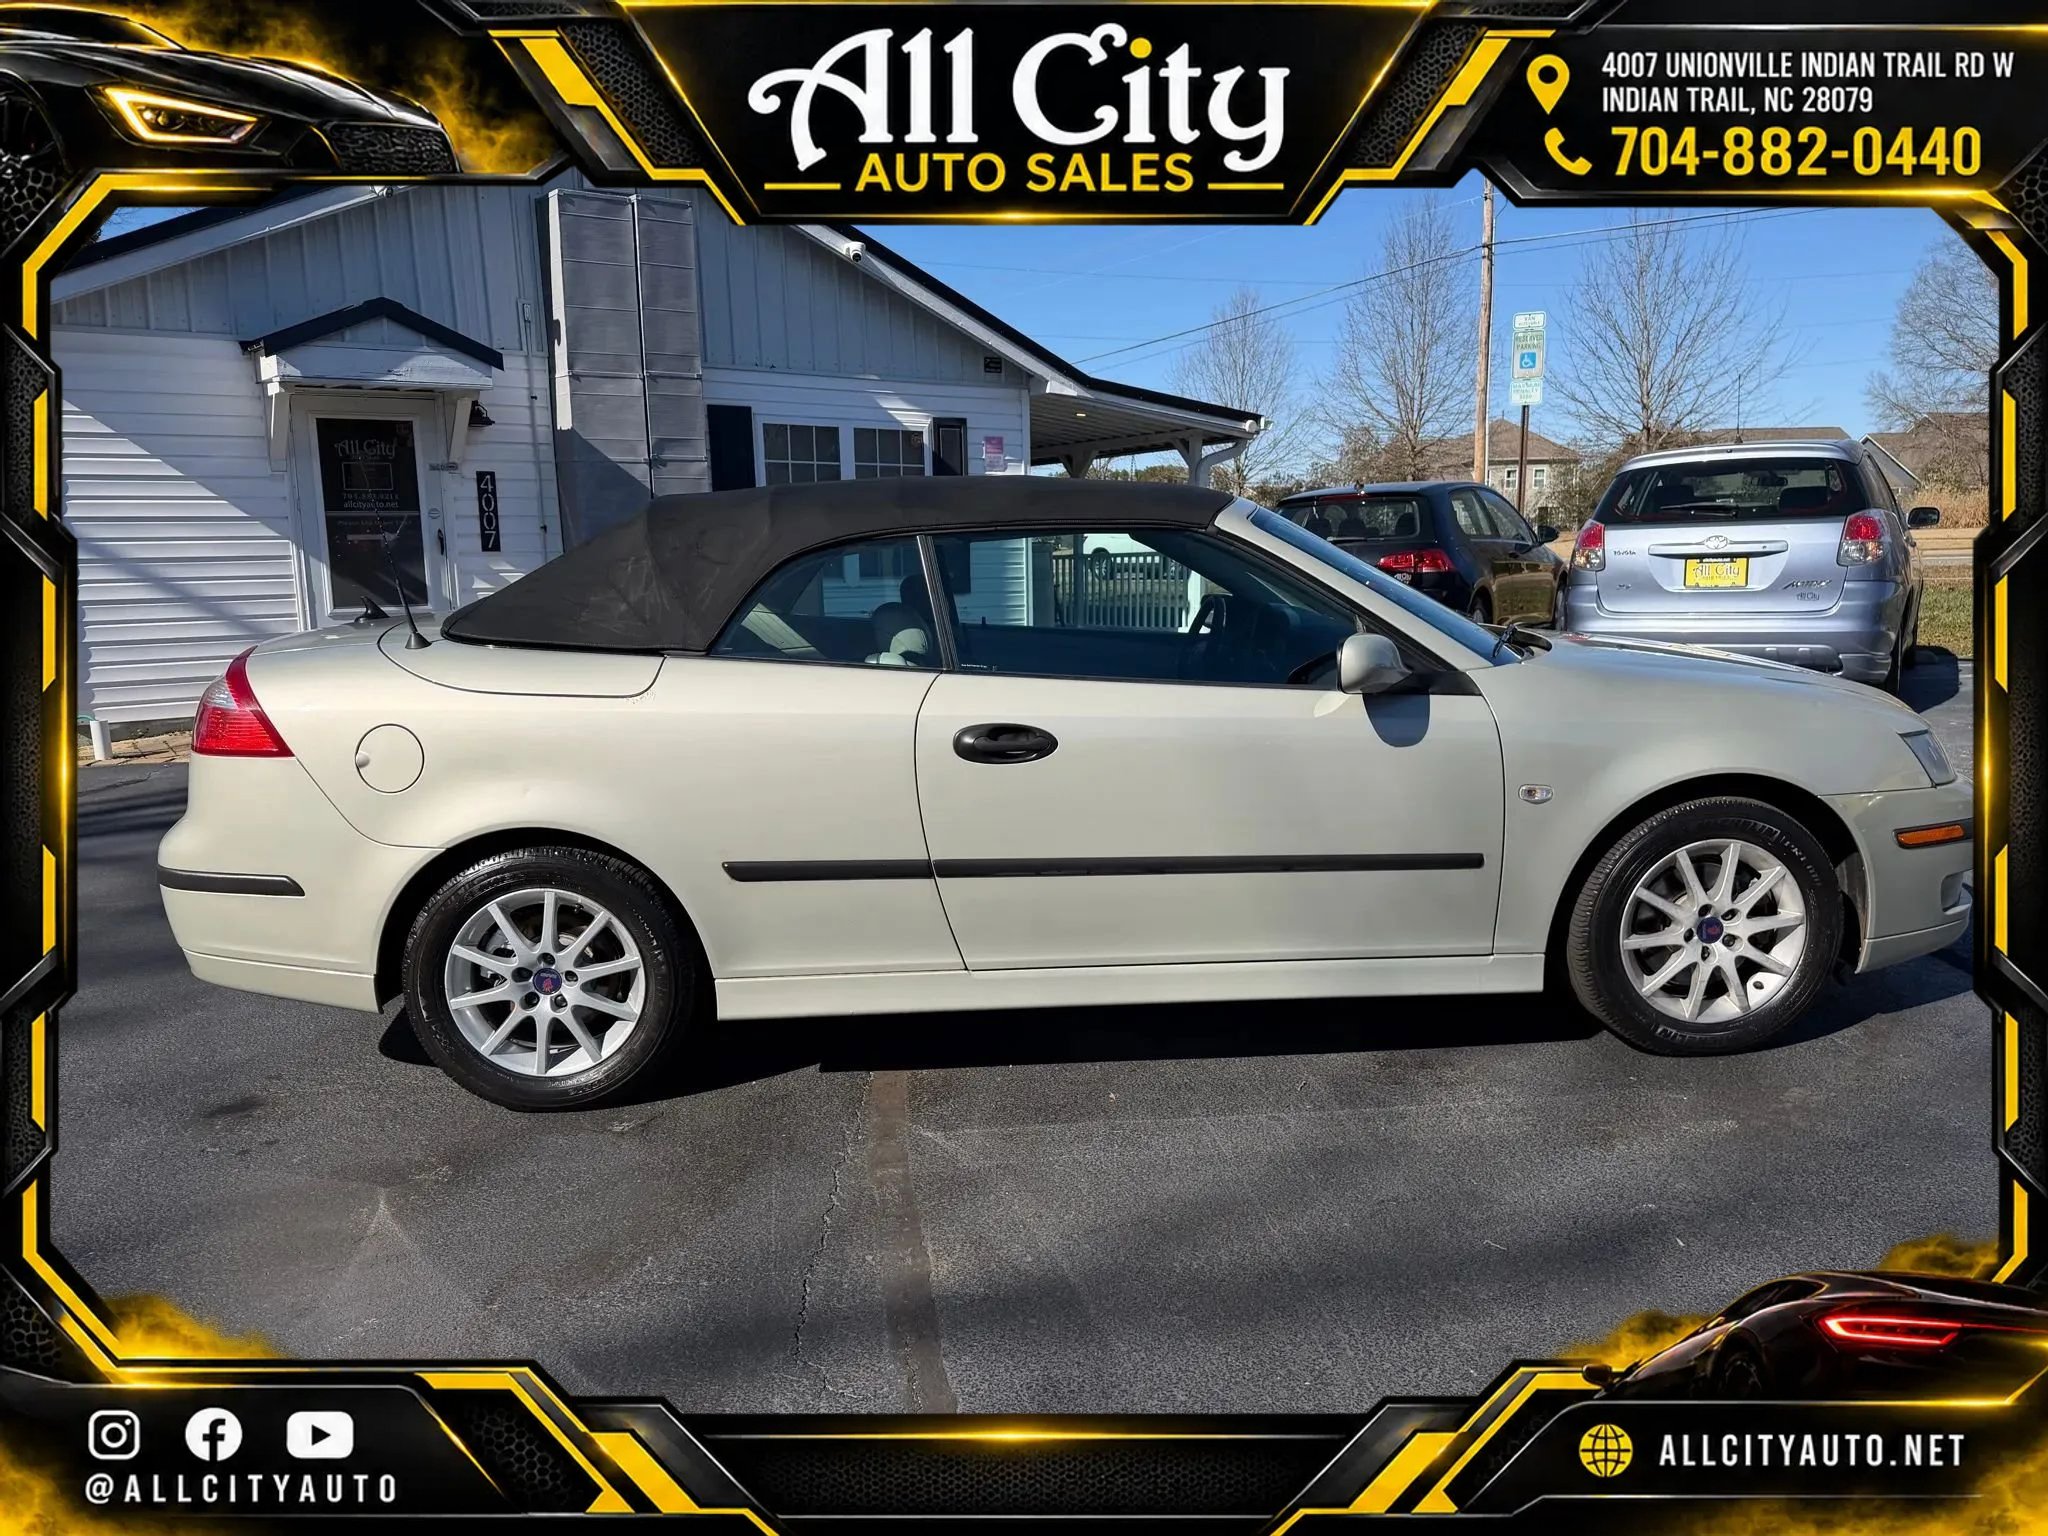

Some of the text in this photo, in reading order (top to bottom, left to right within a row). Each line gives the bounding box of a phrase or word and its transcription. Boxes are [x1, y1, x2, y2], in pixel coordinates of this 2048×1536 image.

[1516, 343, 1542, 351] PARKING
[333, 438, 396, 460] All City
[479, 474, 496, 549] 4007
[1692, 564, 1740, 578] All City
